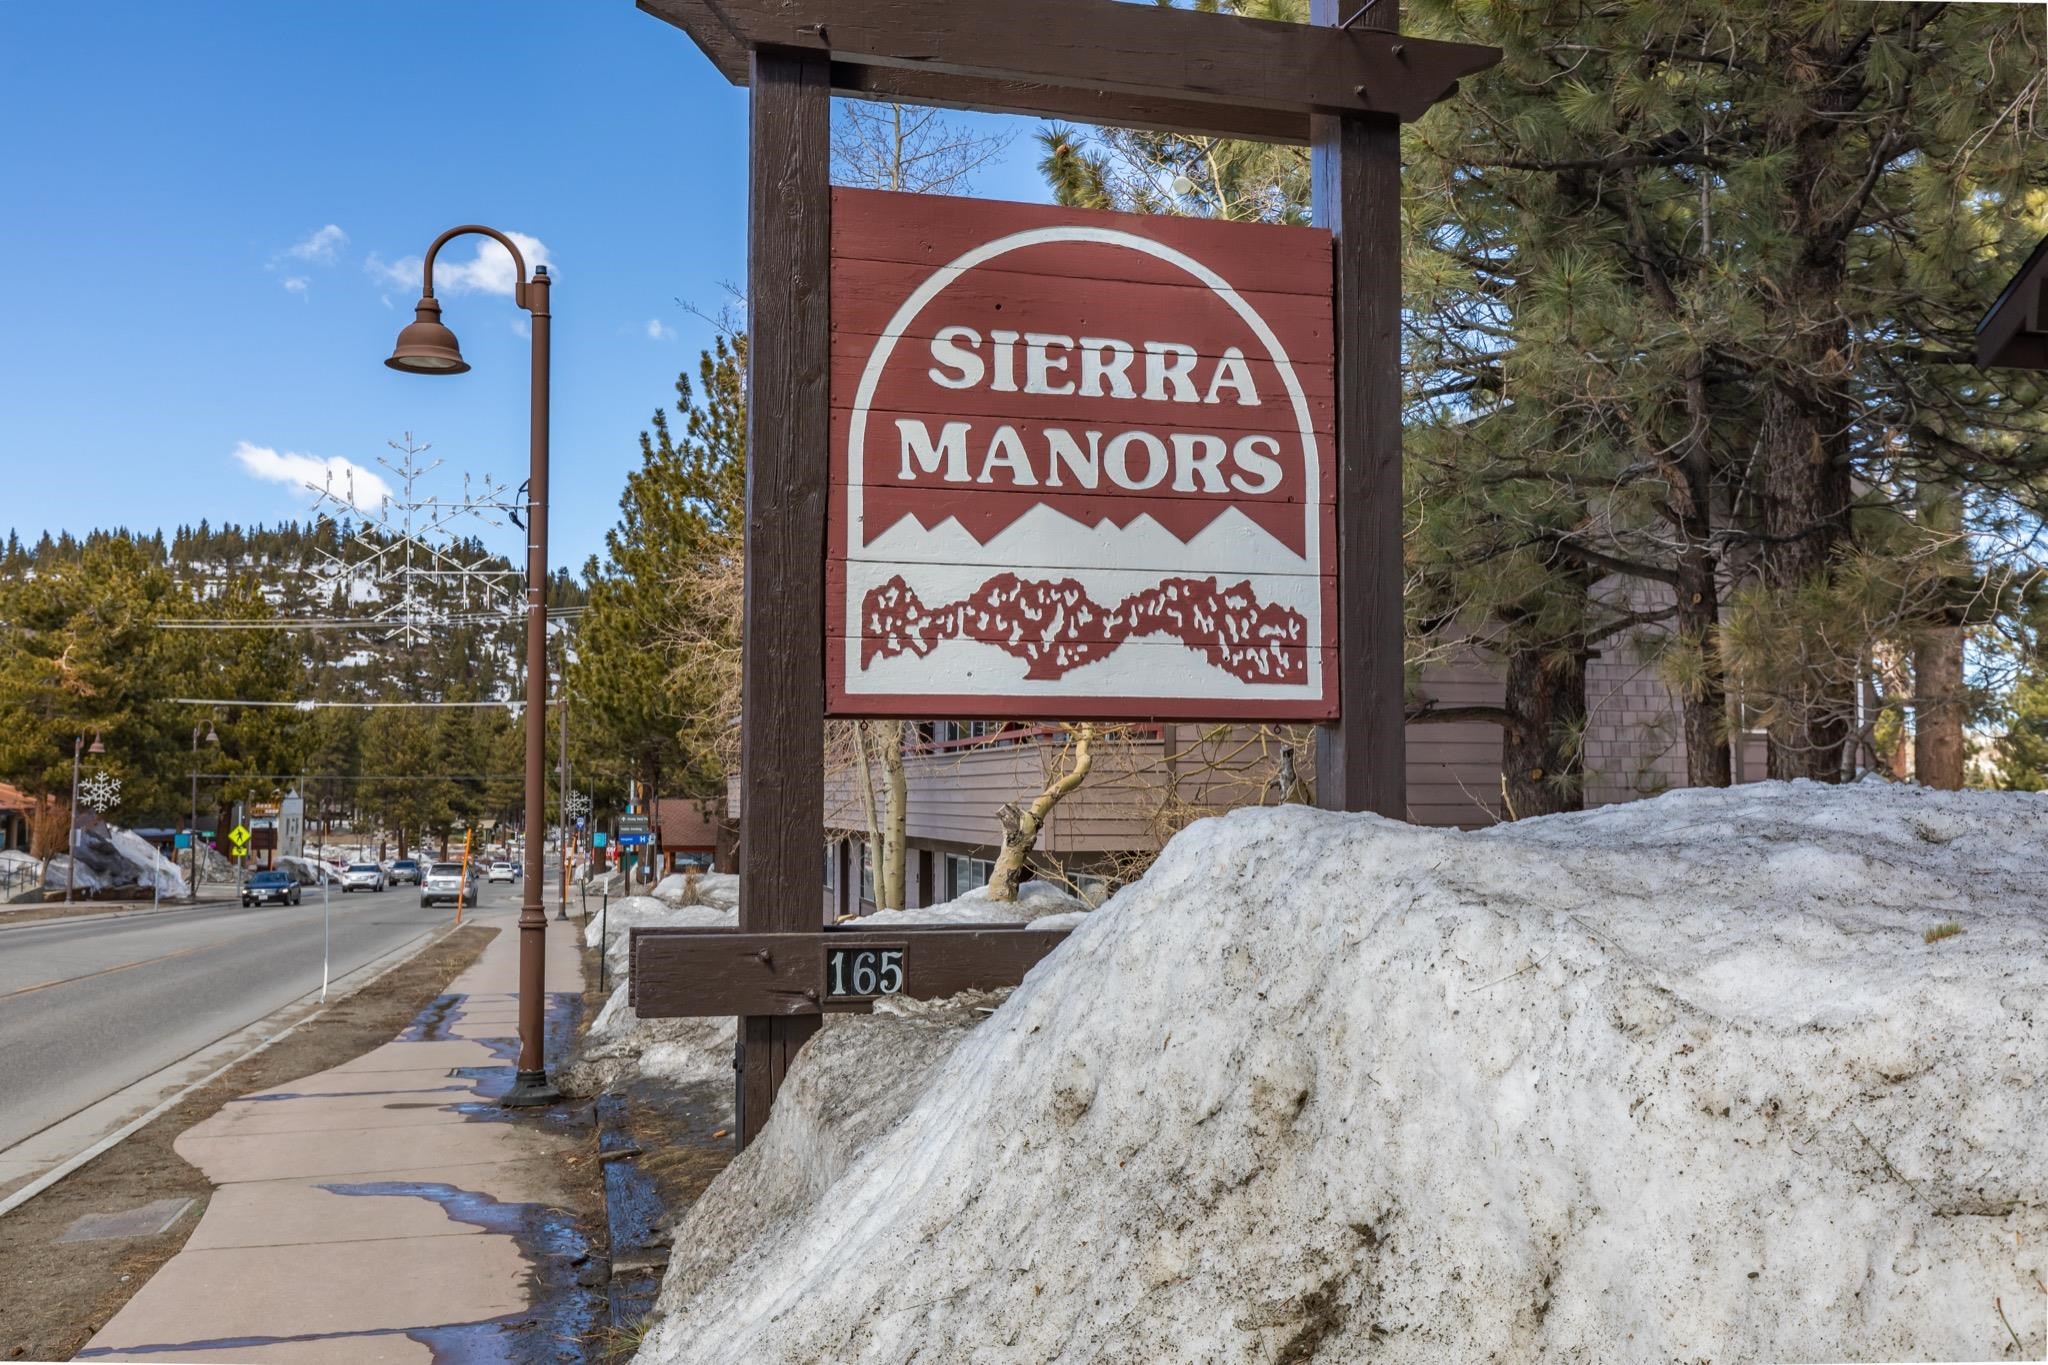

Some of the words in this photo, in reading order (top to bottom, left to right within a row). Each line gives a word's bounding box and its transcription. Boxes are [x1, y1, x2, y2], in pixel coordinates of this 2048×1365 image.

[928, 325, 1262, 406] SIERRA
[895, 418, 1283, 495] MANORS
[831, 951, 903, 995] 165
